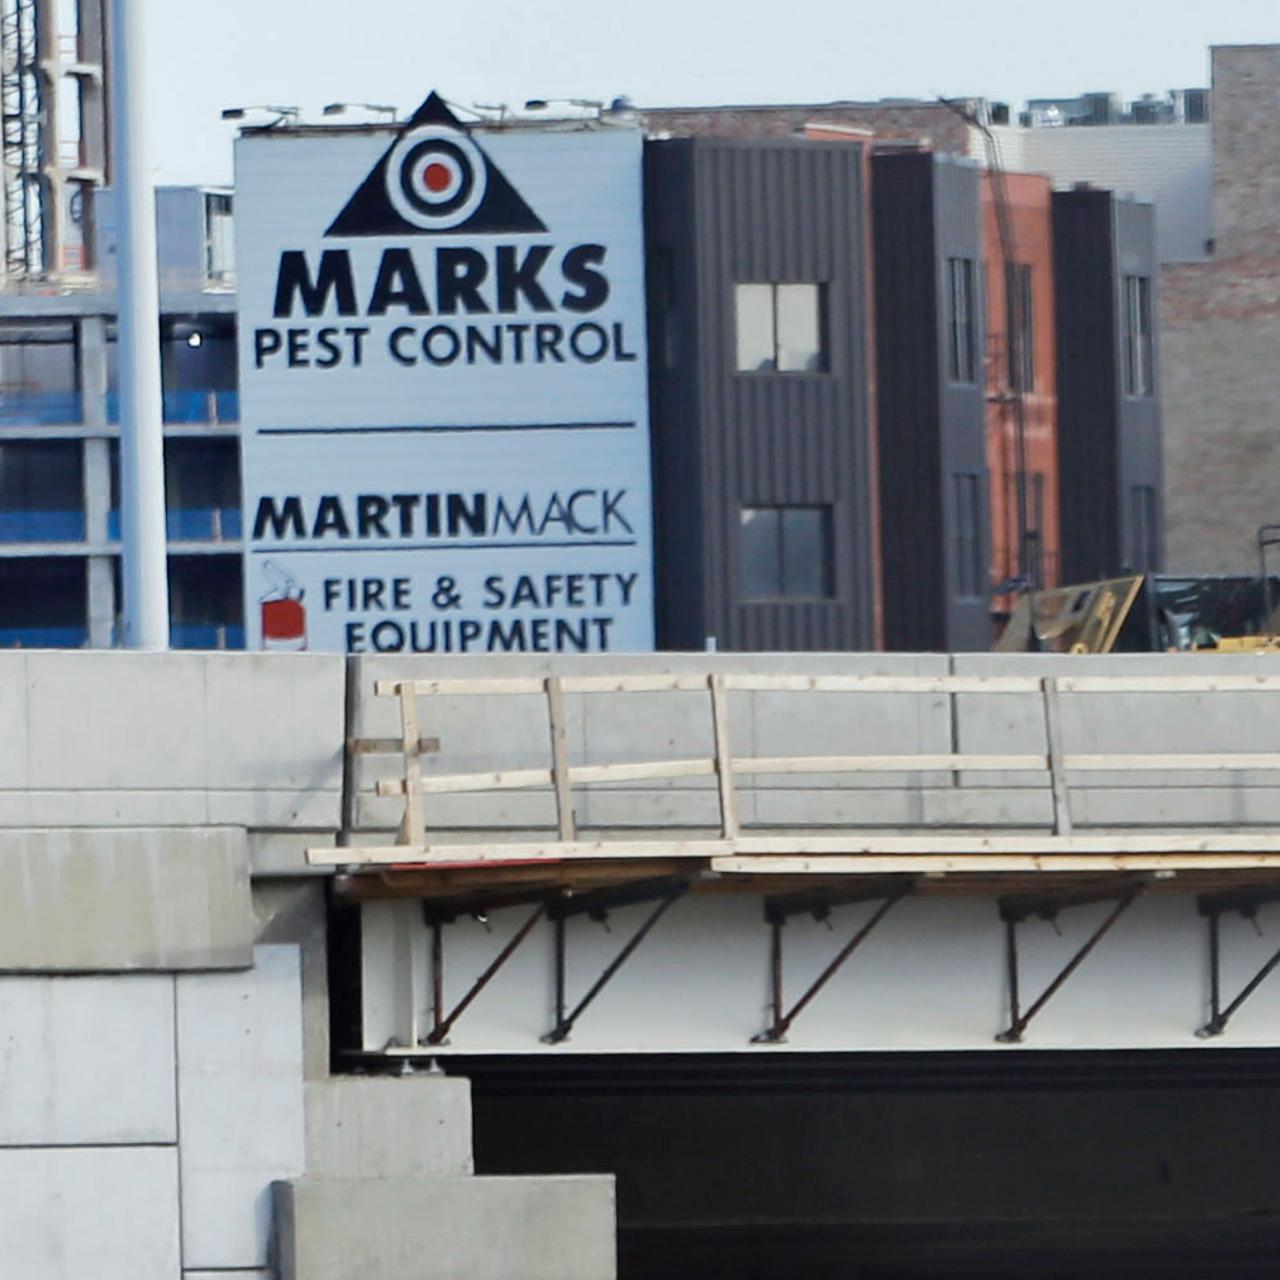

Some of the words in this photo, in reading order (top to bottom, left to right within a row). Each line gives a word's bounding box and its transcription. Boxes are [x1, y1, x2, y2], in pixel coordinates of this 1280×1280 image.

[273, 244, 611, 318] MARKS
[254, 326, 370, 369] PEST
[389, 322, 637, 367] CONTROL
[324, 576, 411, 611] FIRE
[432, 576, 461, 609] &
[485, 573, 638, 608] SAFETY
[345, 618, 614, 653] EQUIPMENT
